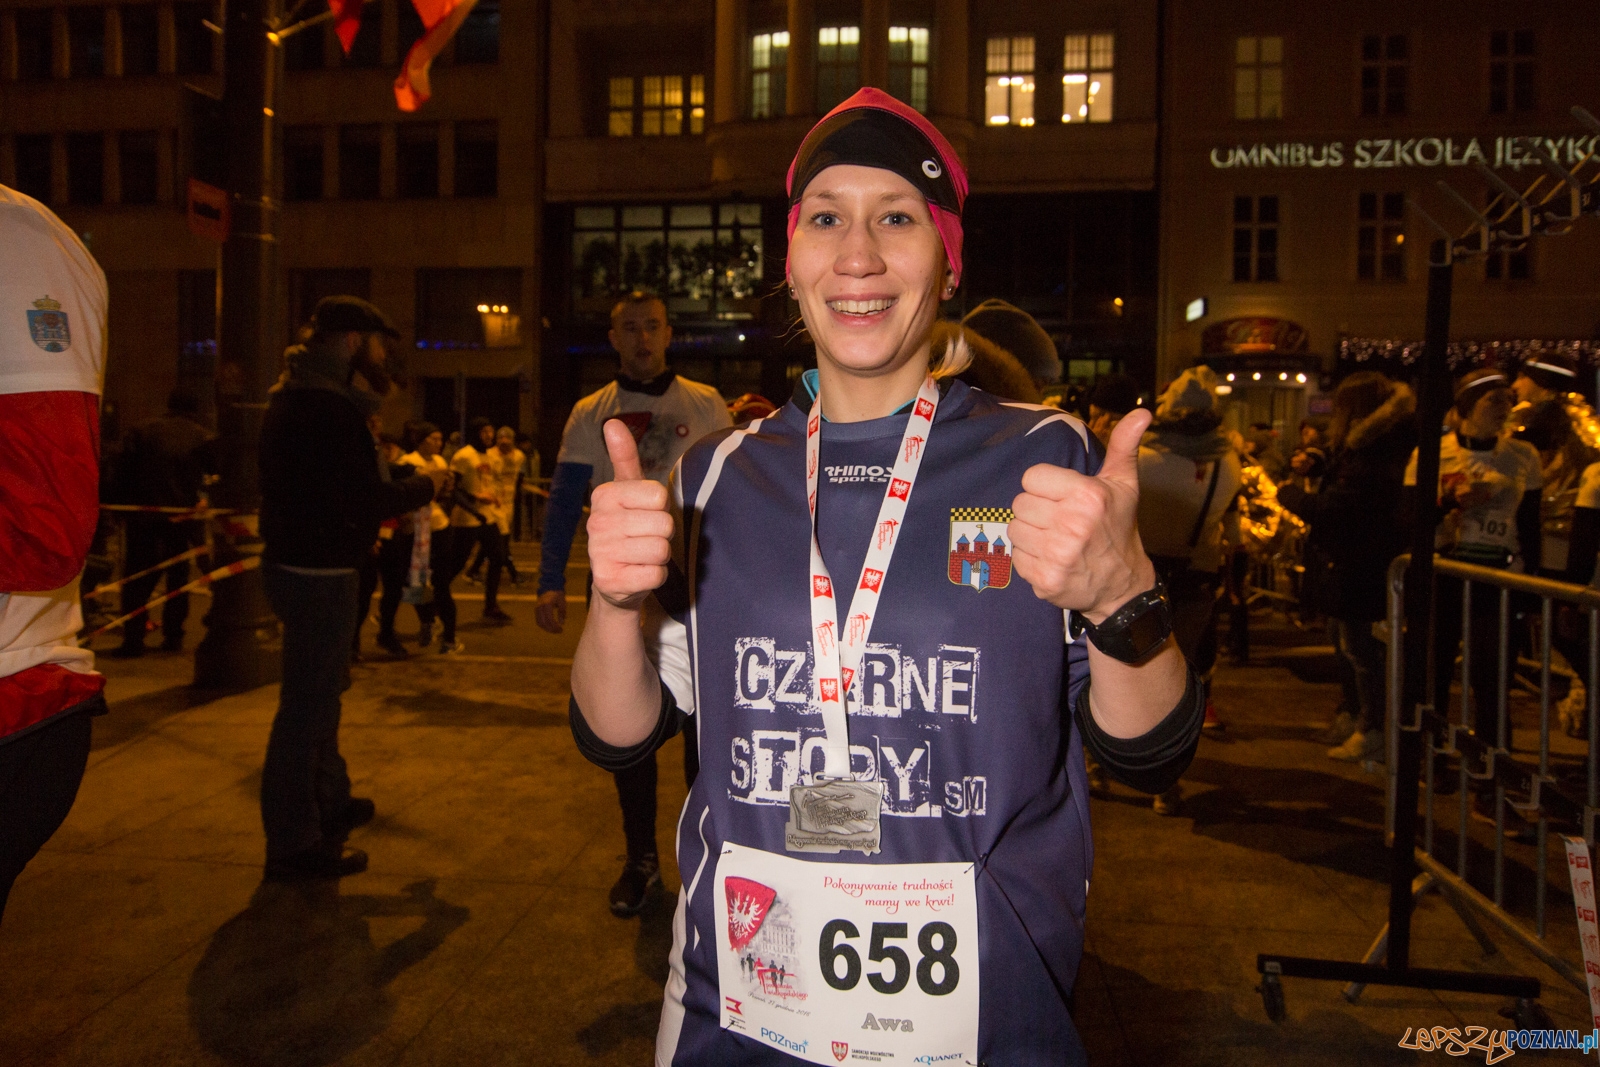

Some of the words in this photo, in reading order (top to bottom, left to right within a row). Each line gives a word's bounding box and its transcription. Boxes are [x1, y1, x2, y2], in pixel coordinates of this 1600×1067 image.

[1210, 141, 1344, 169] OMNIBUS
[1354, 136, 1485, 168] SZKOŁA
[829, 476, 887, 484] sports
[736, 640, 976, 718] CZRNE
[823, 876, 898, 898] Pokonywanie
[903, 878, 953, 891] trudności
[865, 897, 900, 914] mamy
[905, 899, 921, 907] we
[925, 894, 955, 911] krwi!
[818, 918, 960, 996] 658
[861, 1013, 914, 1033] Awa
